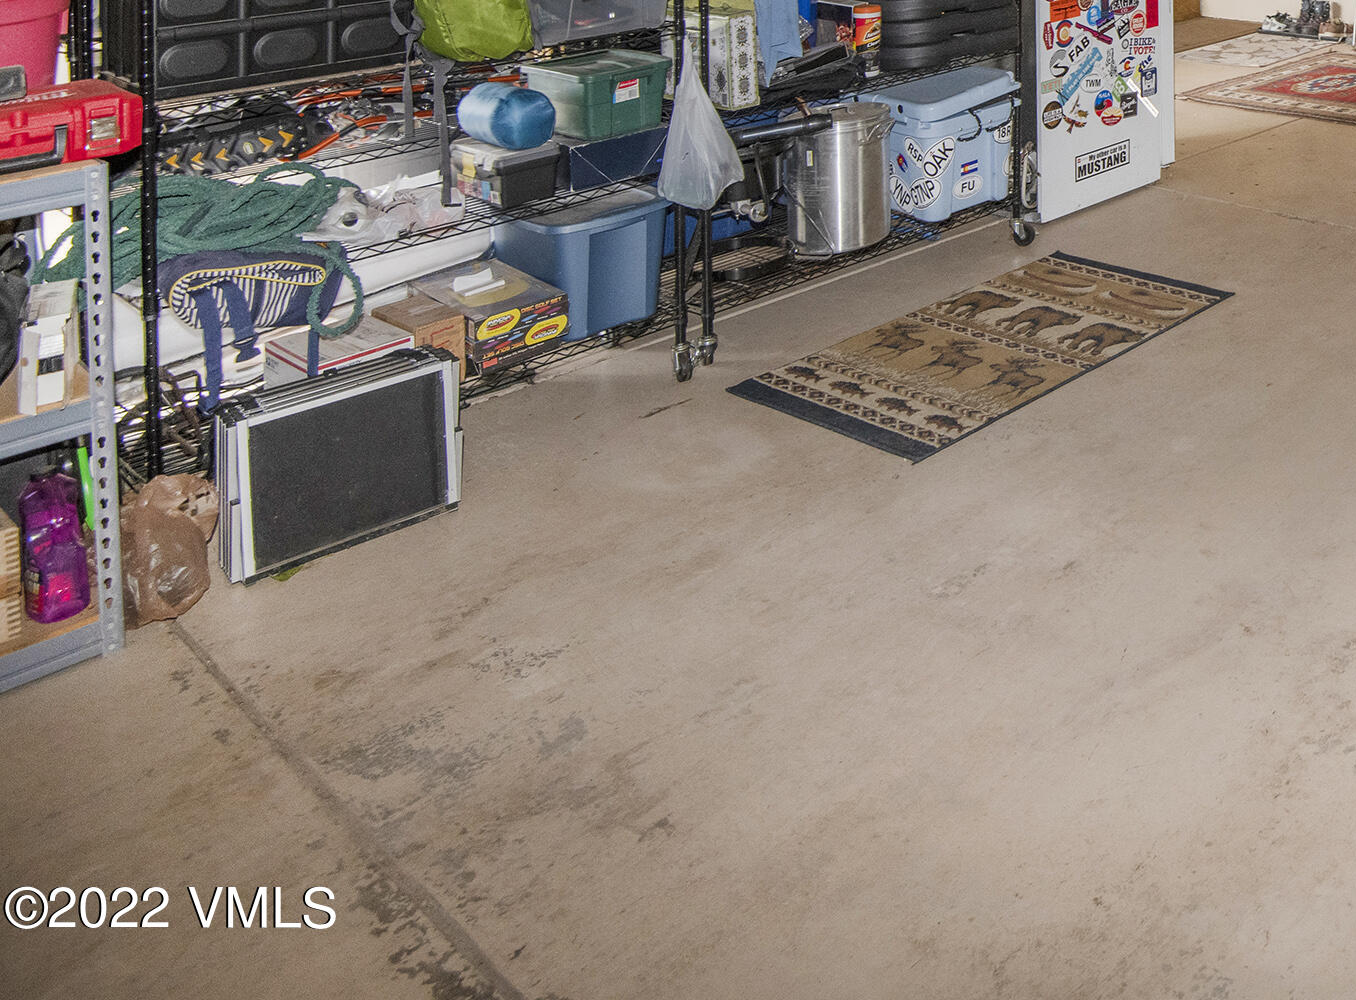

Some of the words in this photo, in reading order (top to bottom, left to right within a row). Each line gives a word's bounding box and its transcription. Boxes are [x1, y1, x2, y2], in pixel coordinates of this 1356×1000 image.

[1068, 36, 1090, 63] FAB
[1133, 37, 1152, 46] BIKE
[1085, 79, 1102, 88] TWM
[906, 142, 923, 162] RSP
[923, 142, 953, 177] OAK
[1077, 150, 1127, 179] MUSTANG
[892, 179, 911, 208] YNP
[910, 179, 935, 206] GTNP
[961, 180, 975, 193] FU
